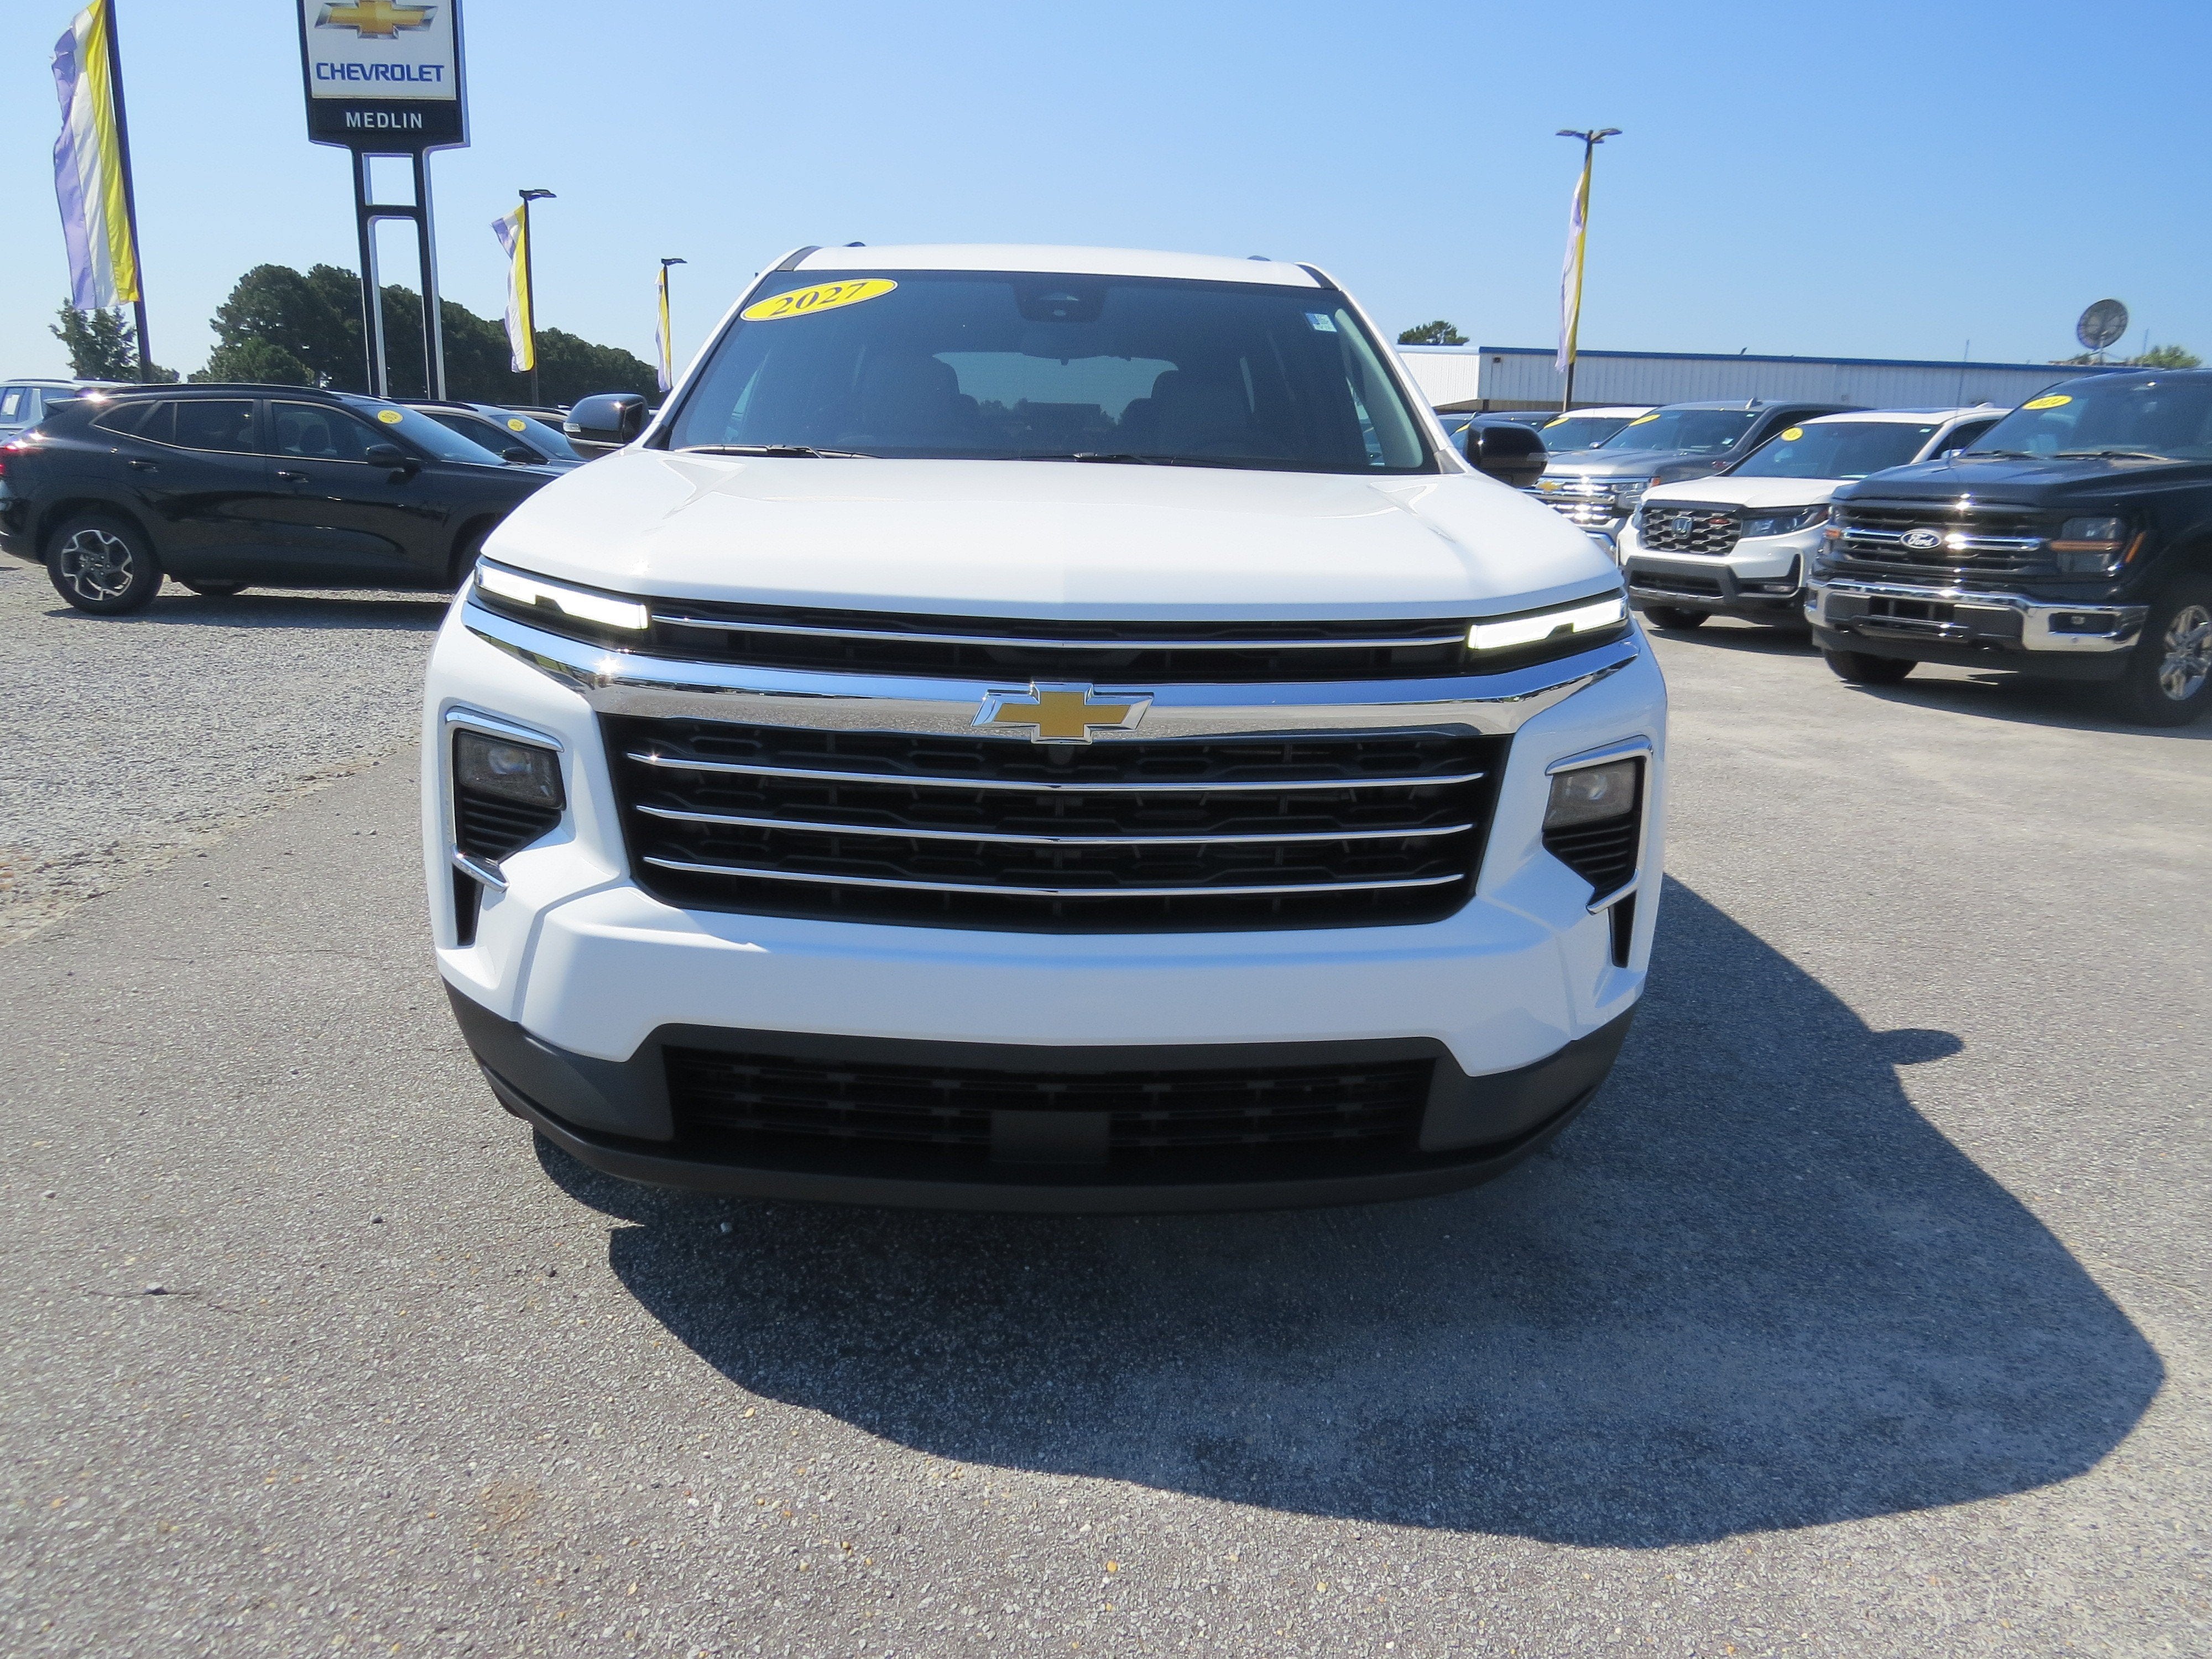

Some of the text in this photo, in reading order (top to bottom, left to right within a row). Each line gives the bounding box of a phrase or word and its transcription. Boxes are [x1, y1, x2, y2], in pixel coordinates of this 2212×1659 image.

[316, 62, 444, 82] CHEVROLET
[346, 112, 422, 128] MEDLIN
[770, 282, 868, 317] 2027
[1908, 534, 1934, 546] Ford
